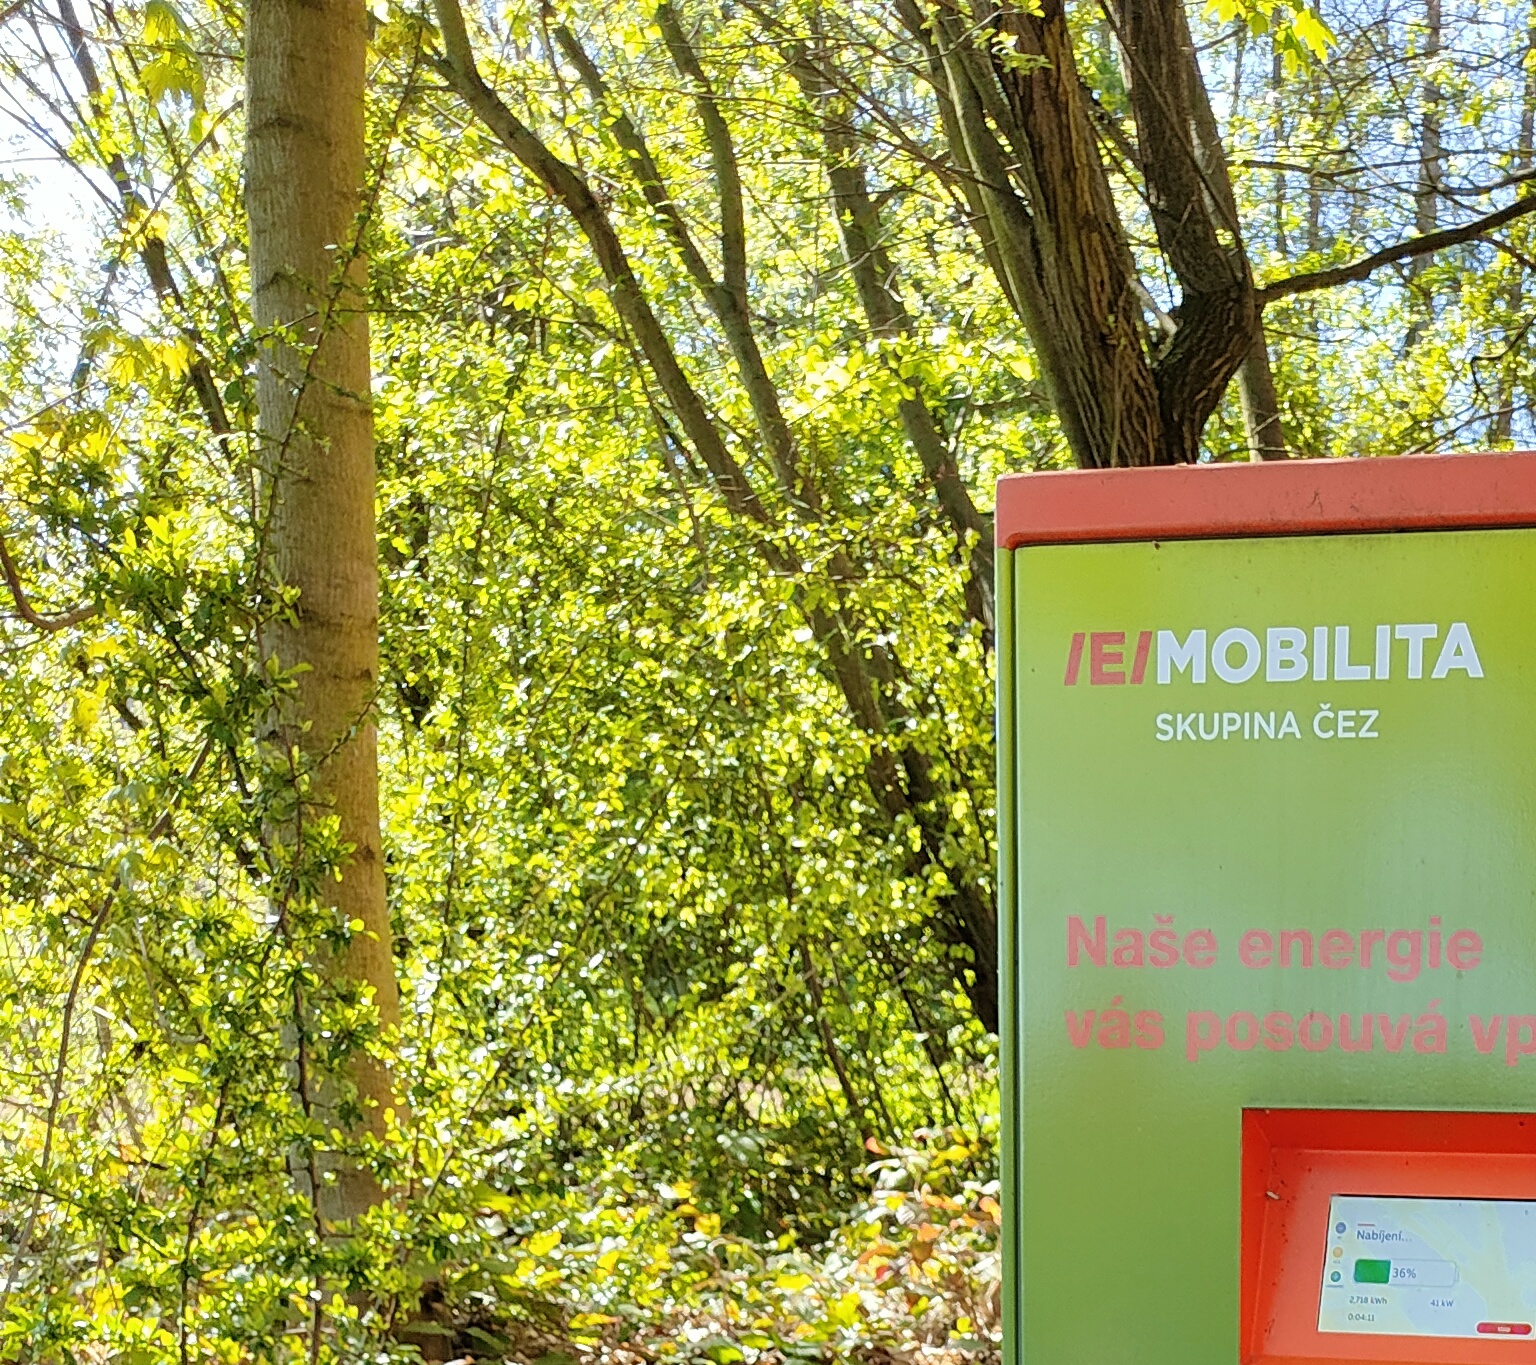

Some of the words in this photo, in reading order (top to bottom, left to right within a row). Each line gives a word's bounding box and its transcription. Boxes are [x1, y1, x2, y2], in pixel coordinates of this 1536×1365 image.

[1155, 711, 1301, 742] SKUPINA
[1313, 703, 1380, 739] ČEZ
[1066, 913, 1218, 969] Naše
[1238, 915, 1484, 983] energie
[1064, 995, 1166, 1049] vás
[1186, 998, 1448, 1062] posouvá
[1392, 1267, 1417, 1279] 36%
